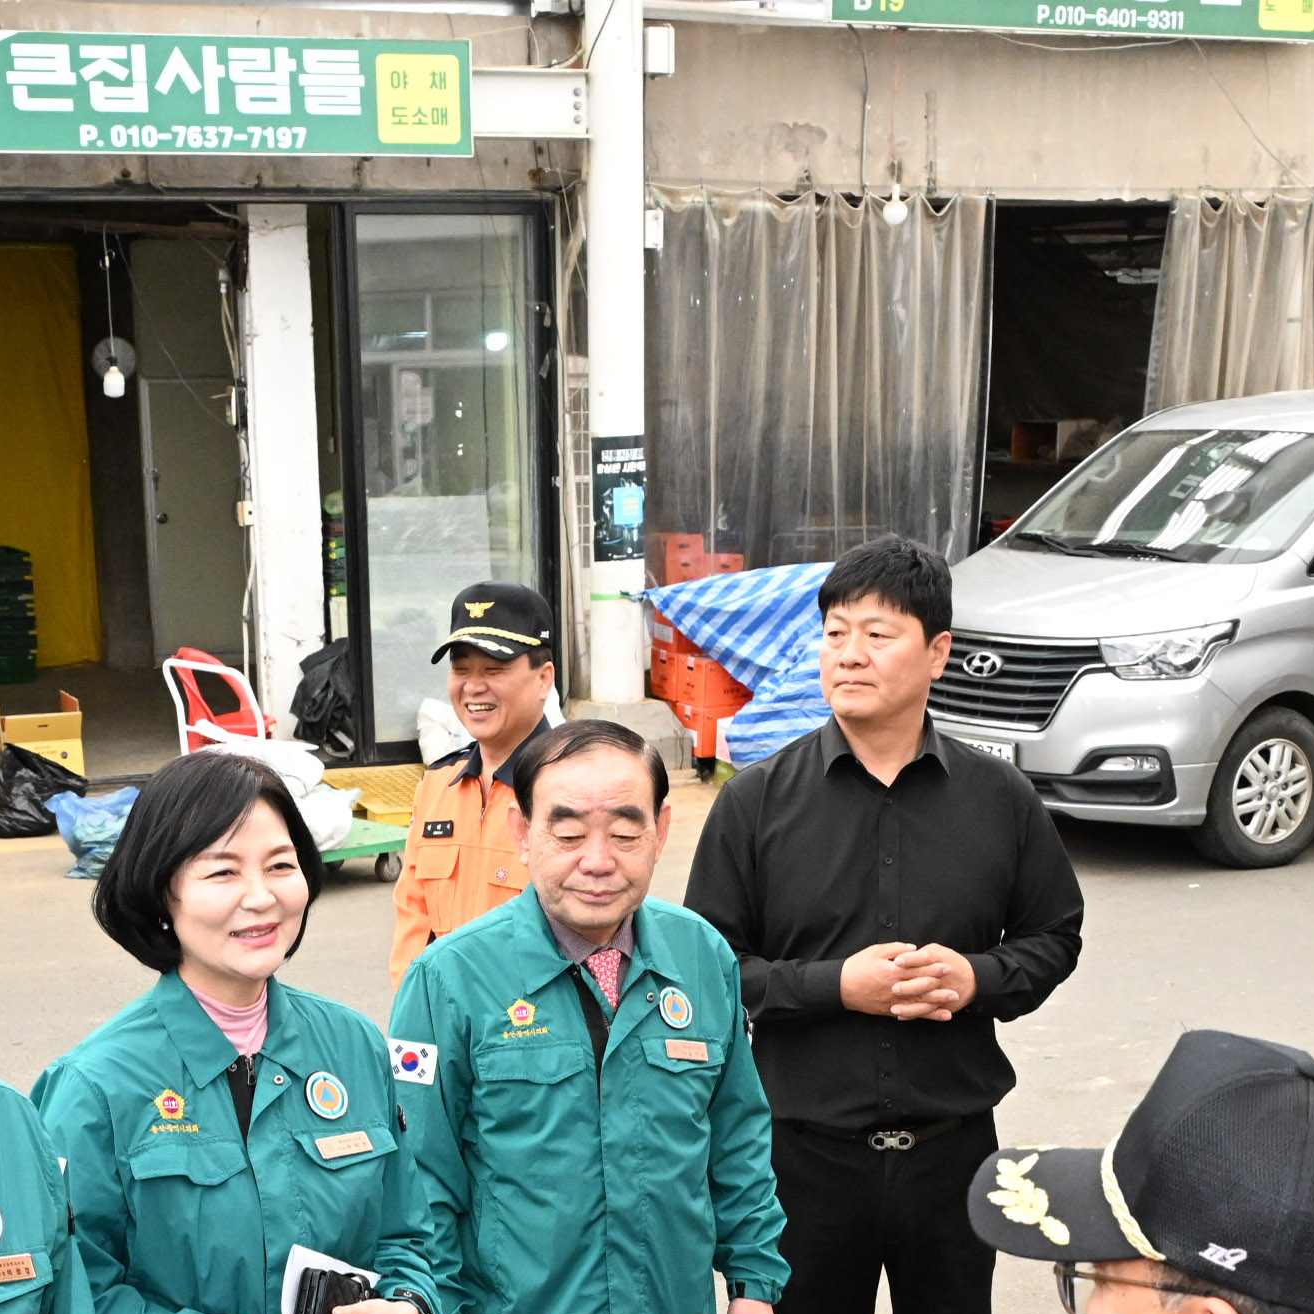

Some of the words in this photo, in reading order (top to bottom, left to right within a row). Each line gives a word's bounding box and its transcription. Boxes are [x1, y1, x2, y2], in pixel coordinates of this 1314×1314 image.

[1036, 5, 1184, 30] P.010-6401-9311
[6, 43, 365, 116] 큰집사람들
[391, 106, 449, 126] 도소매
[110, 125, 307, 149] 010-7637-7197
